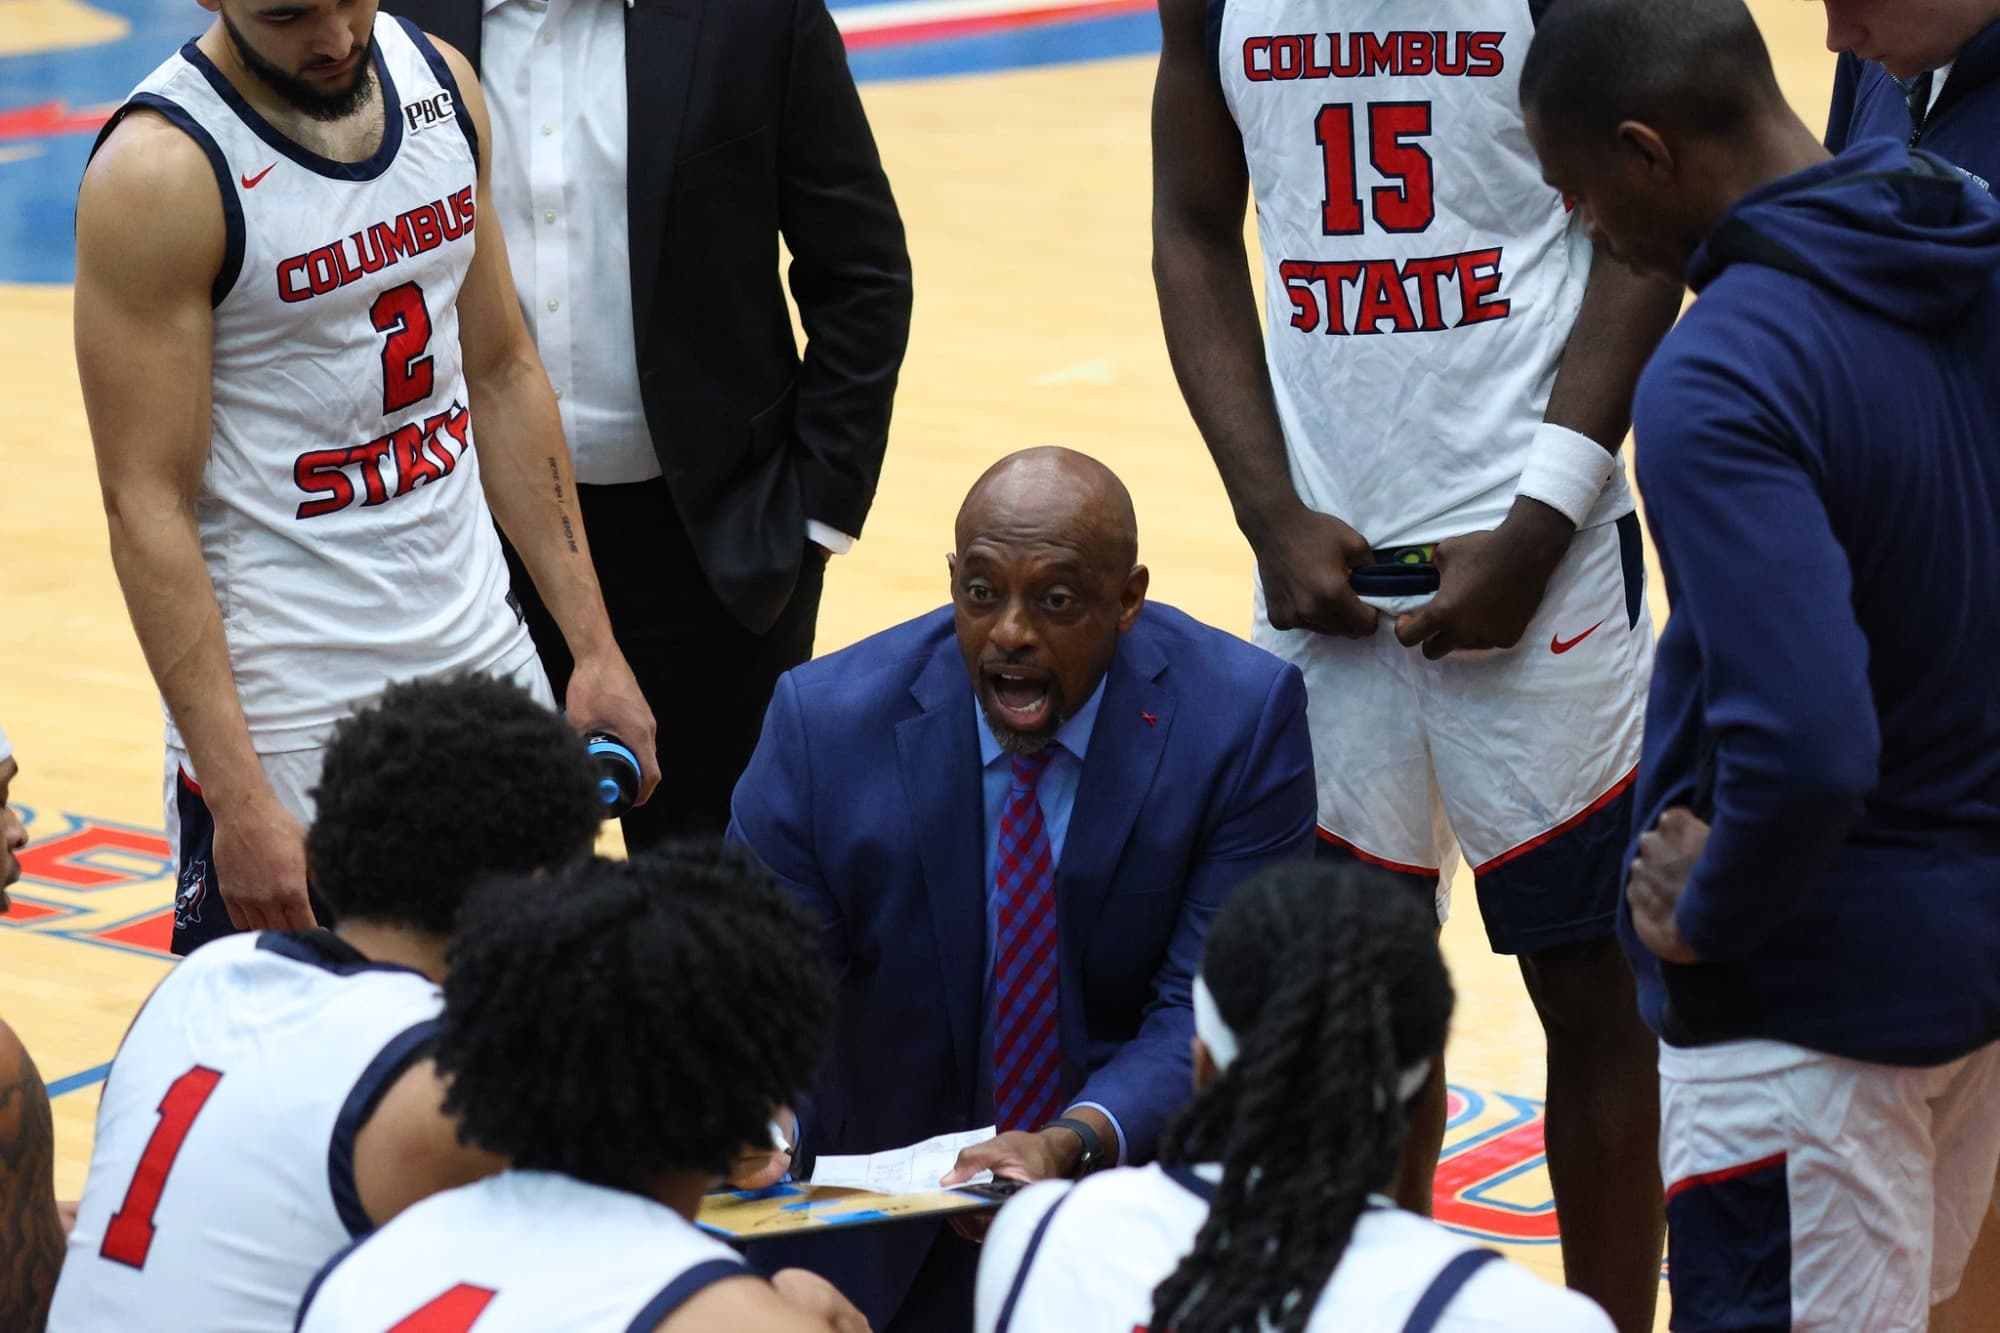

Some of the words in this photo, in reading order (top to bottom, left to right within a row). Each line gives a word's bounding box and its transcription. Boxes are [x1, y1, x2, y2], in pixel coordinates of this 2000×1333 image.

[404, 93, 453, 130] PBC
[1243, 31, 1506, 81] COLUMBUS
[1314, 101, 1435, 236] 15
[276, 184, 475, 303] COLUMBUS
[1279, 246, 1511, 335] STATE
[369, 280, 434, 416] 2
[100, 1064, 224, 1270] 1
